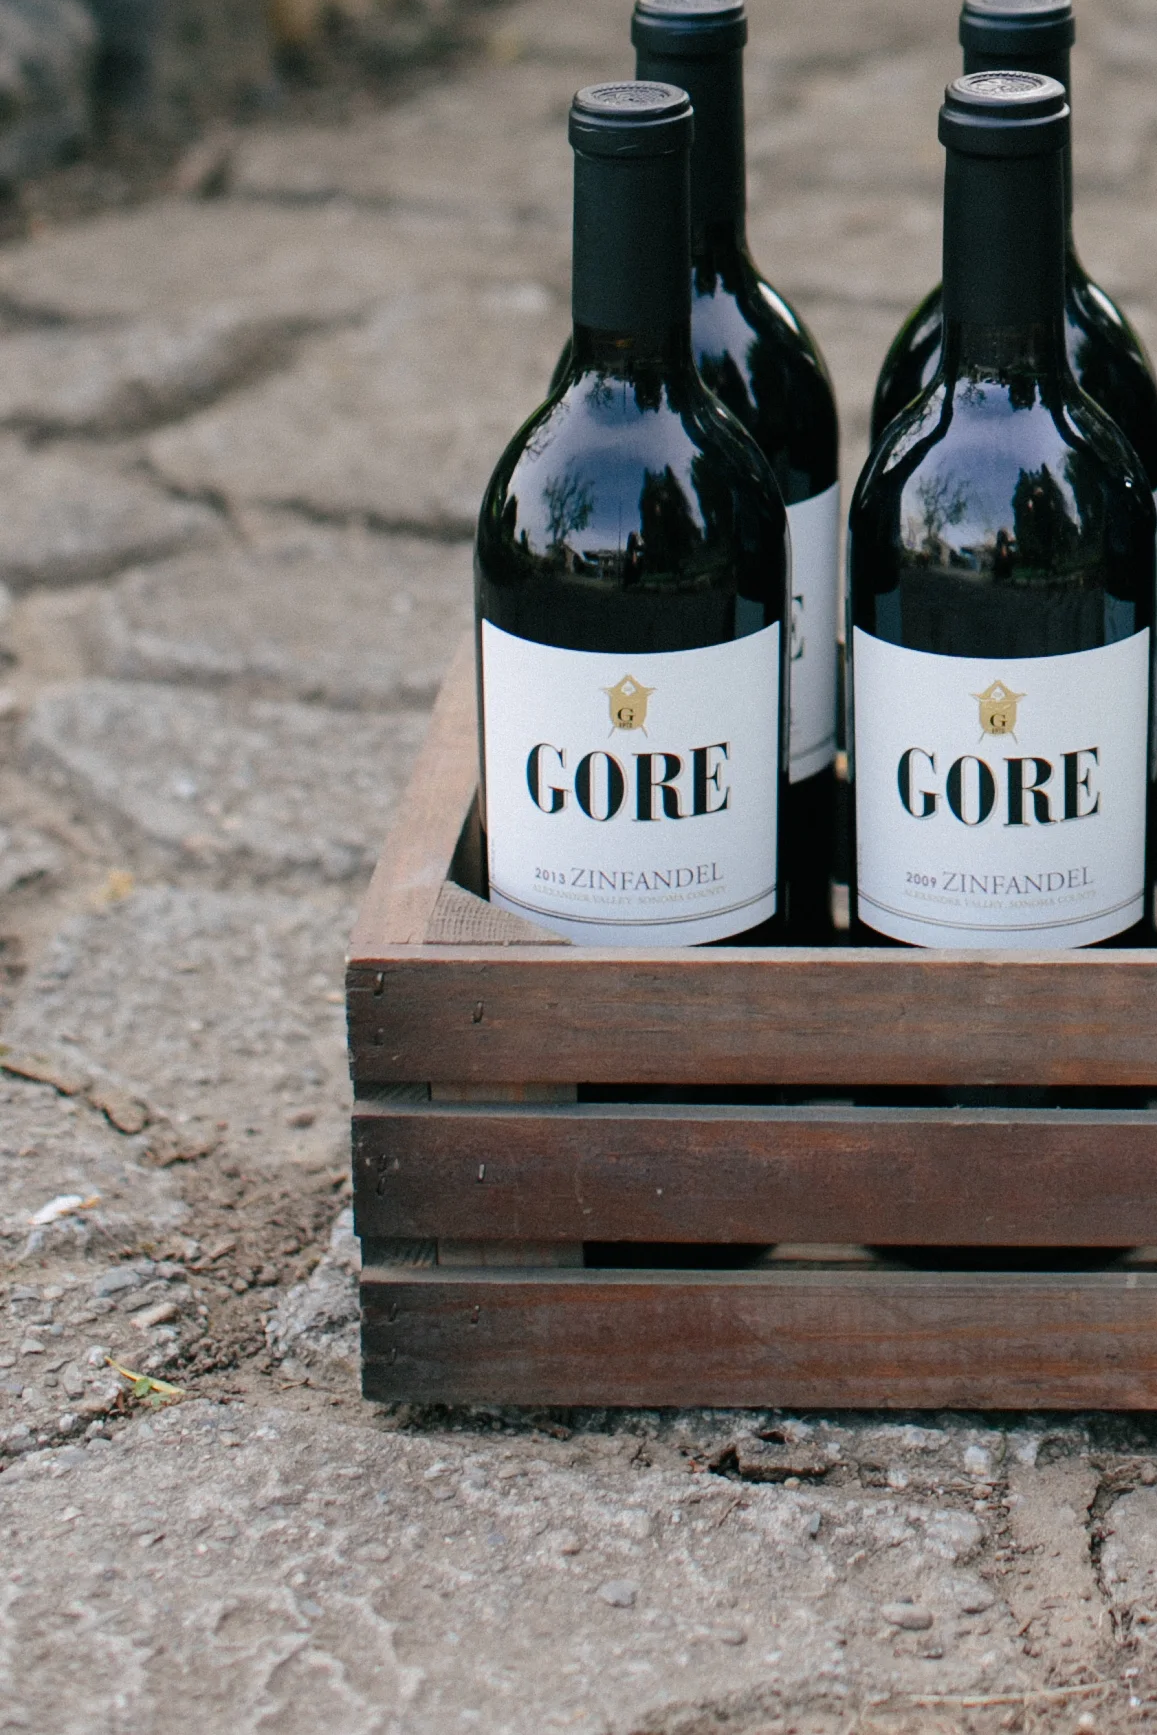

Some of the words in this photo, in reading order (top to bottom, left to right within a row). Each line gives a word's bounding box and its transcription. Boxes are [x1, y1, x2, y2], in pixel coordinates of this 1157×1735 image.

[617, 708, 634, 722] G
[989, 714, 1007, 728] G
[526, 741, 731, 823] GORE
[897, 746, 1101, 827] GORE
[535, 867, 566, 885] 2013
[570, 861, 724, 891] ZINFANDEL
[906, 871, 937, 888] 2009
[942, 866, 1094, 895] ZINFANDEL
